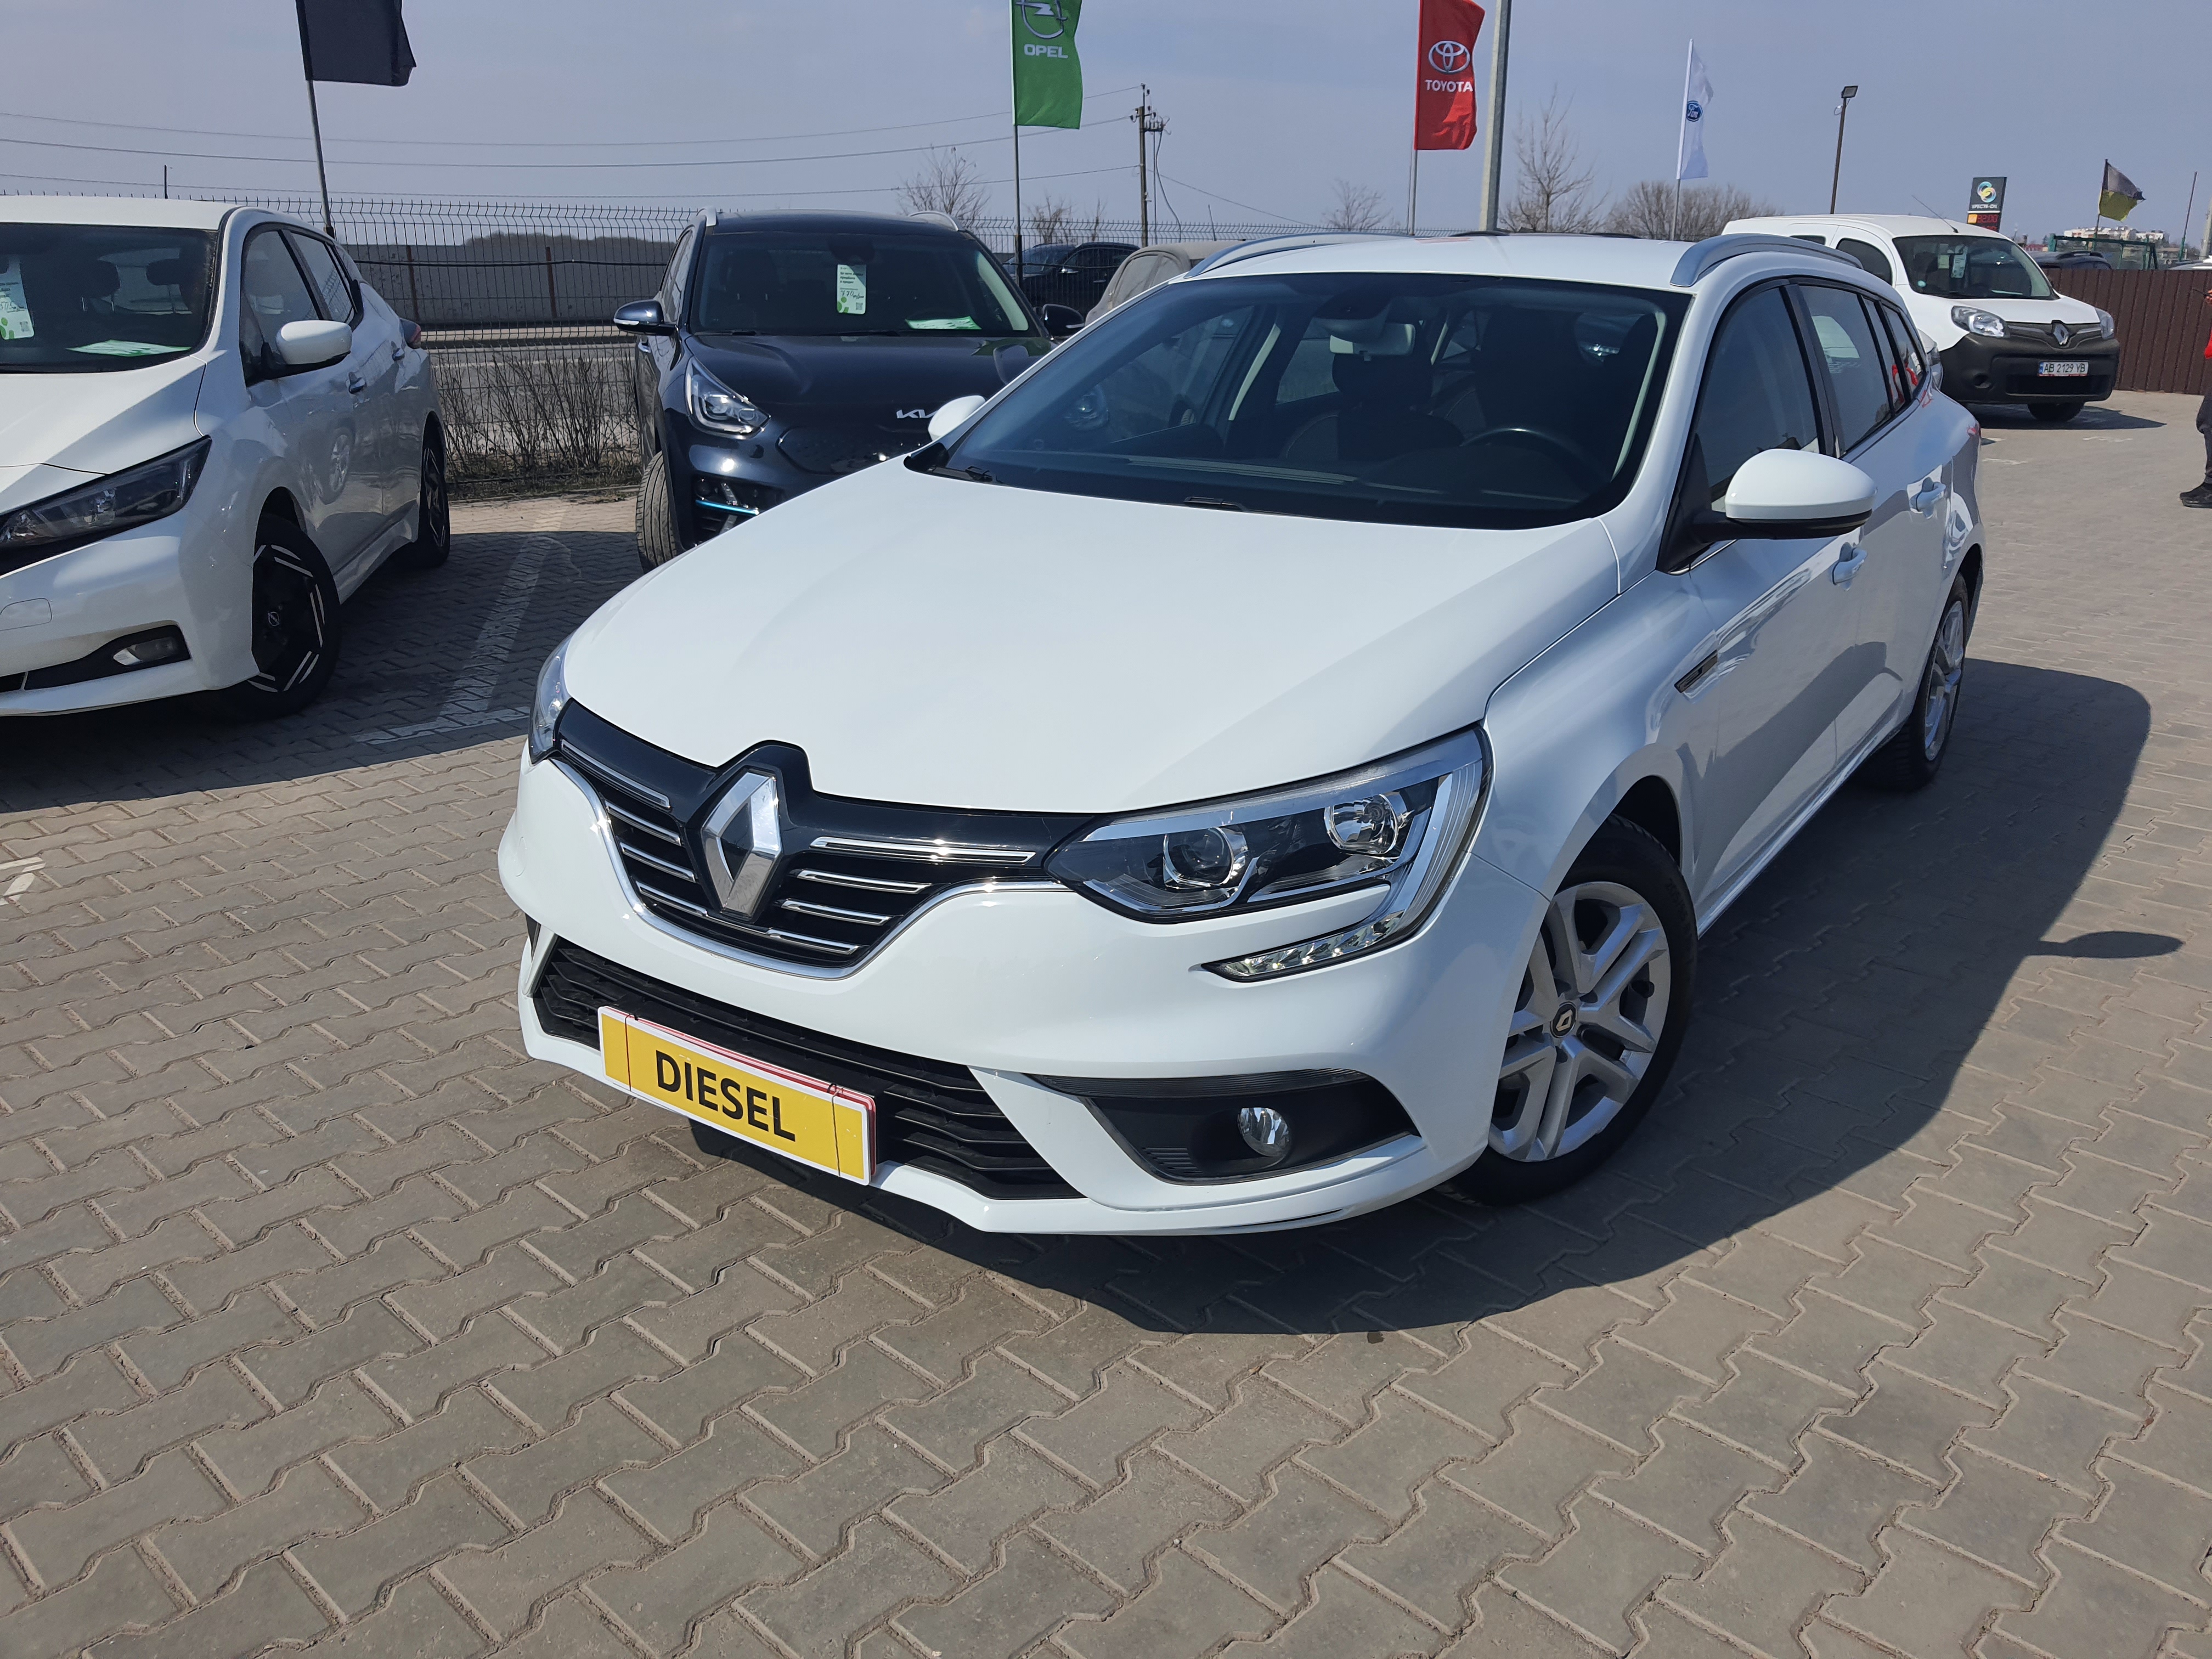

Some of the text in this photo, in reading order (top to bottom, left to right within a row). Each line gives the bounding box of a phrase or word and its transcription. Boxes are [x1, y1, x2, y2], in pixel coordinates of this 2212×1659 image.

[1024, 44, 1069, 59] OPEL
[1425, 79, 1474, 93] TOYOTA
[2044, 363, 2055, 373] AB
[2056, 363, 2074, 373] 2129
[656, 1049, 795, 1142] DIESEL
